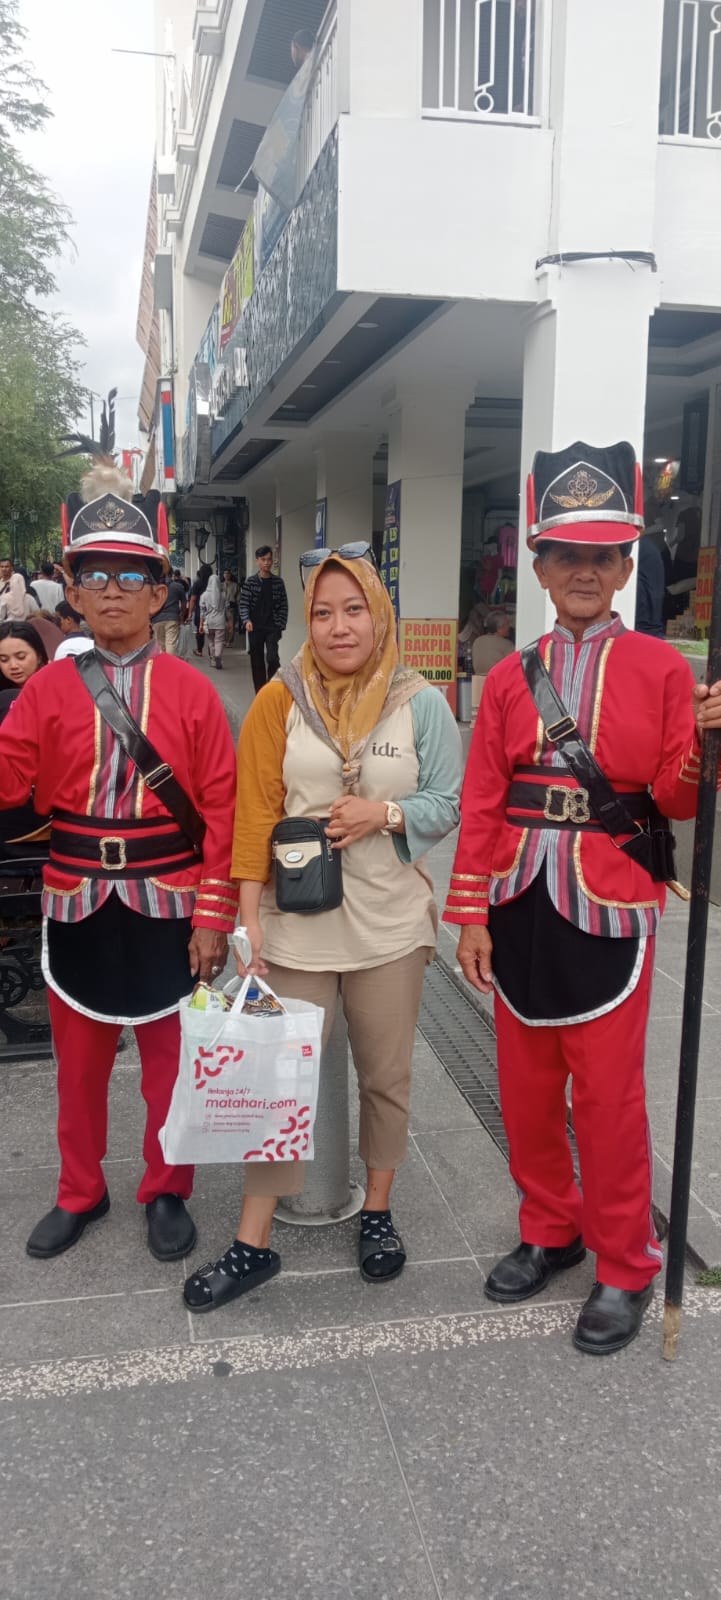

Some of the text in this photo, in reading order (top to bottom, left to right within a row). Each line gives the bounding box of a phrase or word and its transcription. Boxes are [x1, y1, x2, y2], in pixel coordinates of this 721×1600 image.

[405, 623, 451, 636] PROMO
[405, 639, 451, 652] BAKPIA
[403, 654, 451, 667] PATHOK
[235, 1086, 251, 1095] 24/7
[205, 1098, 297, 1110] matahari.com
